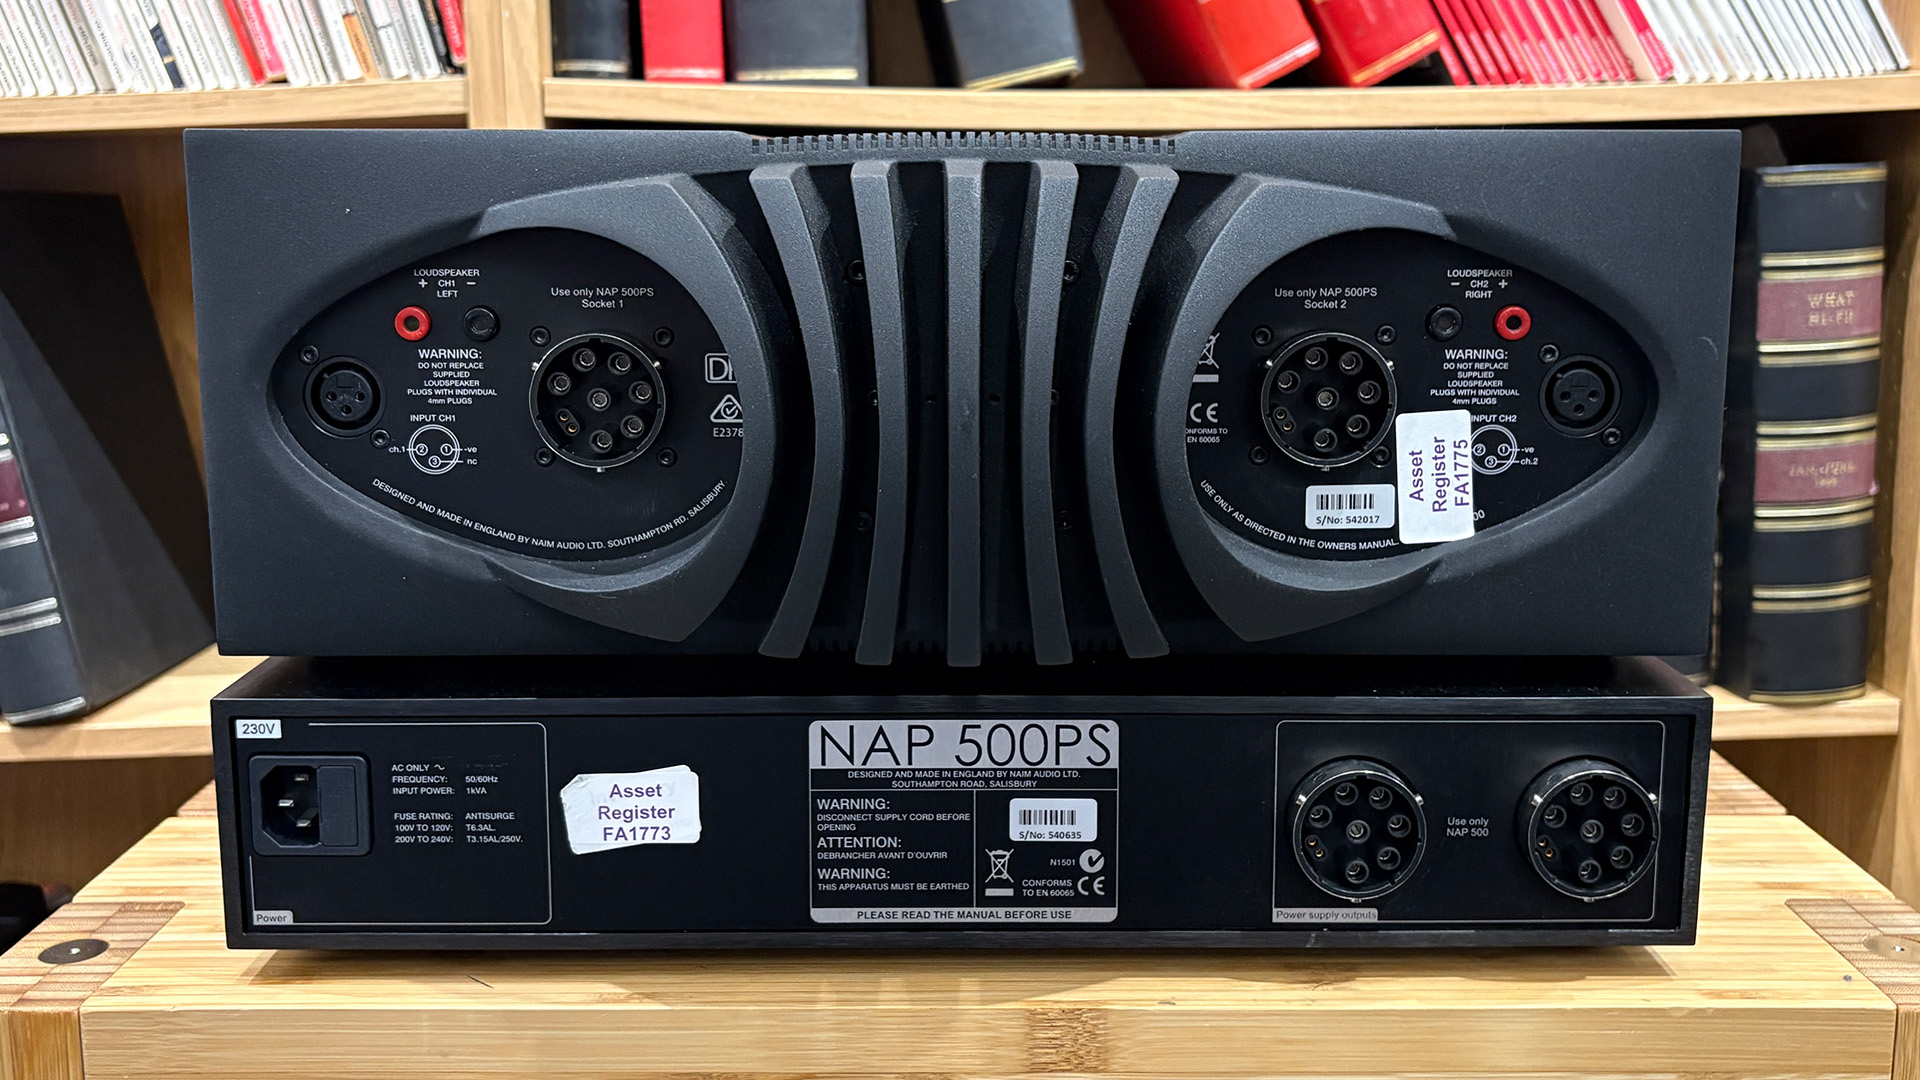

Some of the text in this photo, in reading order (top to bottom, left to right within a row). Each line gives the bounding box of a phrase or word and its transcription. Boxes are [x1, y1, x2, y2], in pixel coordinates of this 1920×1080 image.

[414, 269, 480, 277] LOUDSPEAKER
[1447, 269, 1513, 277] LOUDSPEAKER
[551, 287, 654, 298] Use only NAP 500PS
[1274, 287, 1378, 299] Use only NAP 500PS
[1465, 291, 1493, 299] RIGHT
[581, 299, 624, 309] Socket 1
[1304, 300, 1347, 309] Socket 2
[418, 348, 482, 359] WARNING:
[1445, 349, 1508, 359] WARNING:
[1408, 449, 1424, 501] Asset
[1431, 436, 1450, 512] Register
[1453, 439, 1470, 506] FA1775
[372, 478, 416, 505] DESIGNED
[416, 501, 436, 514] AND
[436, 508, 463, 524] MADE
[463, 518, 473, 528] IN
[473, 522, 516, 541] ENGLAND
[517, 535, 530, 545] BY
[531, 538, 555, 548] NAIM
[556, 542, 585, 550] AUDIO
[586, 541, 606, 549] LTD.
[607, 522, 674, 548] SOUTHAMPTON
[673, 515, 689, 526] RD.
[1200, 479, 1214, 497] USE
[1213, 494, 1233, 514] ONLY
[1232, 510, 1244, 522] AS
[1243, 517, 1286, 542] DIRECTED
[1286, 535, 1297, 544] IN
[1298, 537, 1316, 548] THE
[1317, 540, 1357, 551] OWNERS
[1316, 515, 1380, 525] S/No: 542017
[242, 723, 275, 735] 230V
[820, 723, 1111, 767] NAP 500PS
[392, 775, 499, 783] FREQUENCY: 50/60Hz
[848, 770, 1081, 779] DESIGNED AND MADE IN ENGLAND BY NAIM AUDIO LTD.
[892, 780, 1037, 788] SOUTHAMPTON ROAD, SALISBURY
[609, 784, 662, 798] Asset
[817, 798, 890, 810] WARNING:
[394, 812, 515, 820] FUSE RATING: ANTISURGE
[598, 805, 676, 823] Register
[817, 813, 970, 821] DISCONNECT SUPPLY CORD BEFORE
[1447, 817, 1489, 827] Use only
[394, 824, 496, 832] 100V TO 120V: T6.3AL.
[1446, 828, 1489, 837] NAP 500
[603, 826, 671, 841] FA1773
[1019, 831, 1082, 840] S/No: 540635
[394, 835, 524, 843] 200V TO 240V: T3.15AL/250V.
[817, 836, 902, 848] ATTENTION:
[817, 868, 890, 879] WARNING:
[818, 883, 970, 891] THIS APPARATUS MUST BE EARTHED
[256, 914, 287, 923] Power
[857, 911, 1072, 919] PLEASE READ THE MANUAL BEFORE USE
[1276, 910, 1377, 920] Power supply outputs
